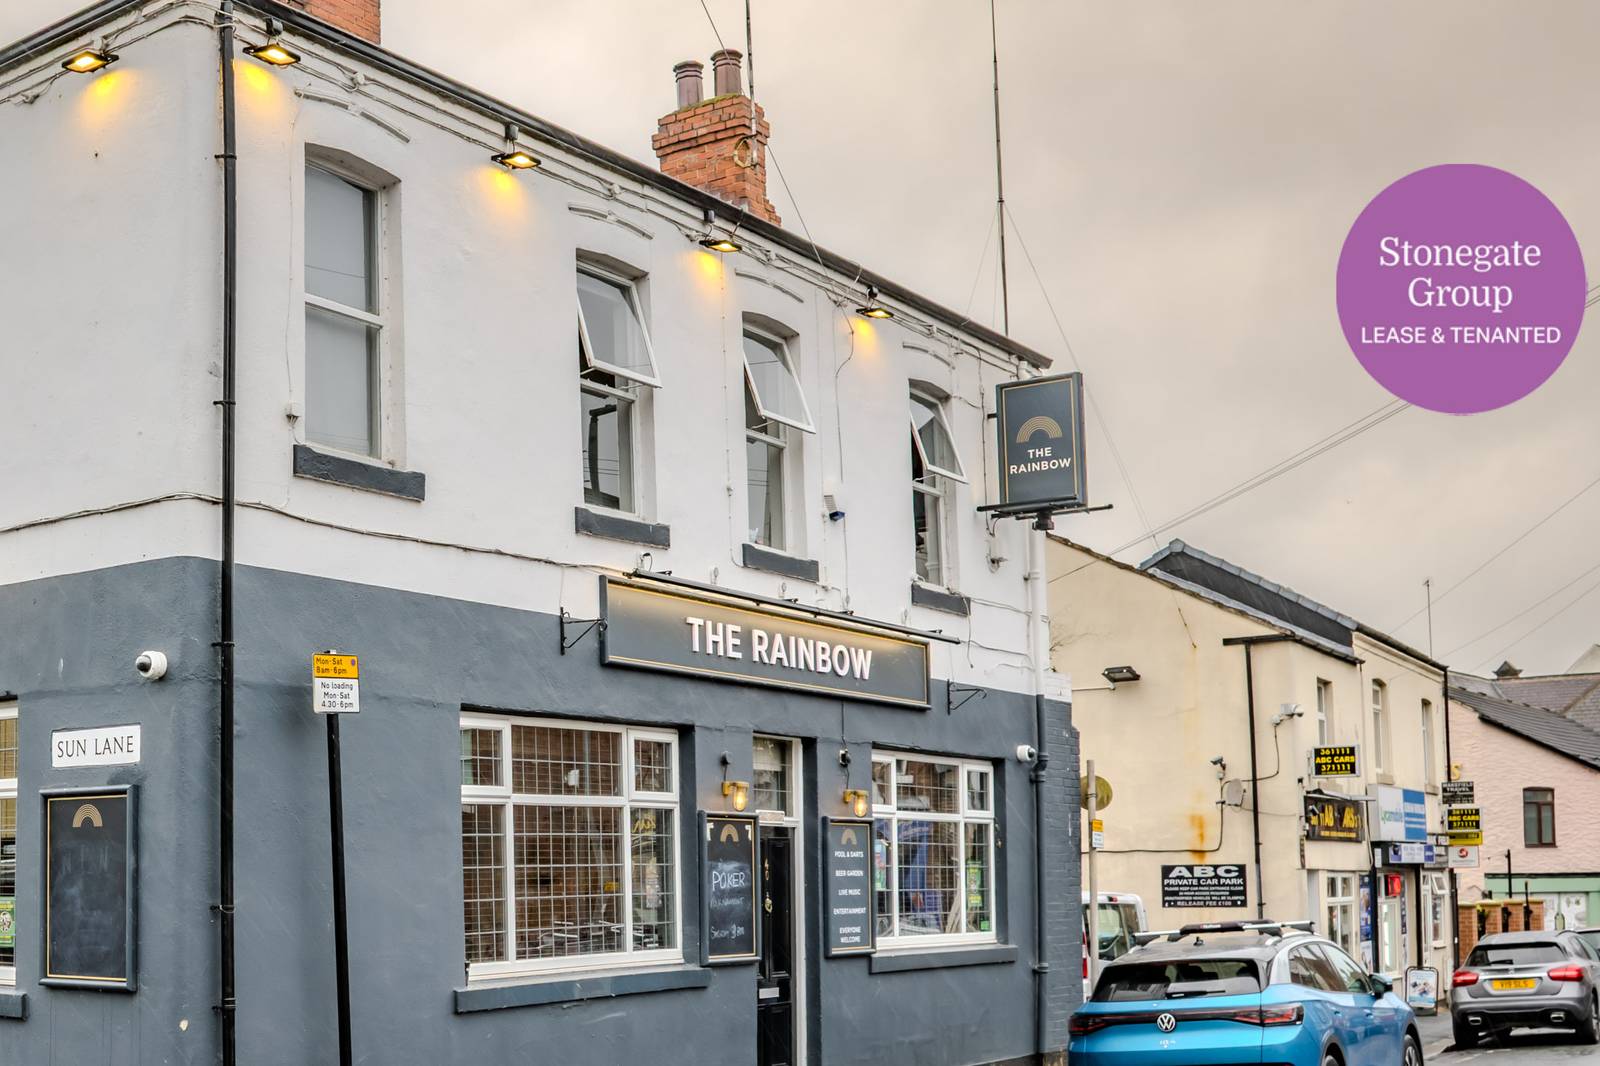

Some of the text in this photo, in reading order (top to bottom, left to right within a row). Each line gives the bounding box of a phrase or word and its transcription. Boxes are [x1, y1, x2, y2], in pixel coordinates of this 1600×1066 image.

[1027, 447, 1052, 459] THE
[1009, 458, 1071, 474] RAINBOW
[685, 616, 873, 680] THE RAINBOW
[321, 681, 354, 691] No loading
[57, 735, 134, 758] SUN LANE
[1320, 747, 1350, 756] 361111
[1321, 763, 1351, 771] 371111
[835, 869, 864, 877] BEER GARDEN
[1168, 866, 1239, 878] ABC
[711, 870, 746, 892] POKER
[1164, 878, 1198, 886] PRIVATE
[833, 907, 867, 915] ENTERTAINMENT
[839, 926, 861, 934] EVERYONE
[840, 935, 861, 943] WELCOME
